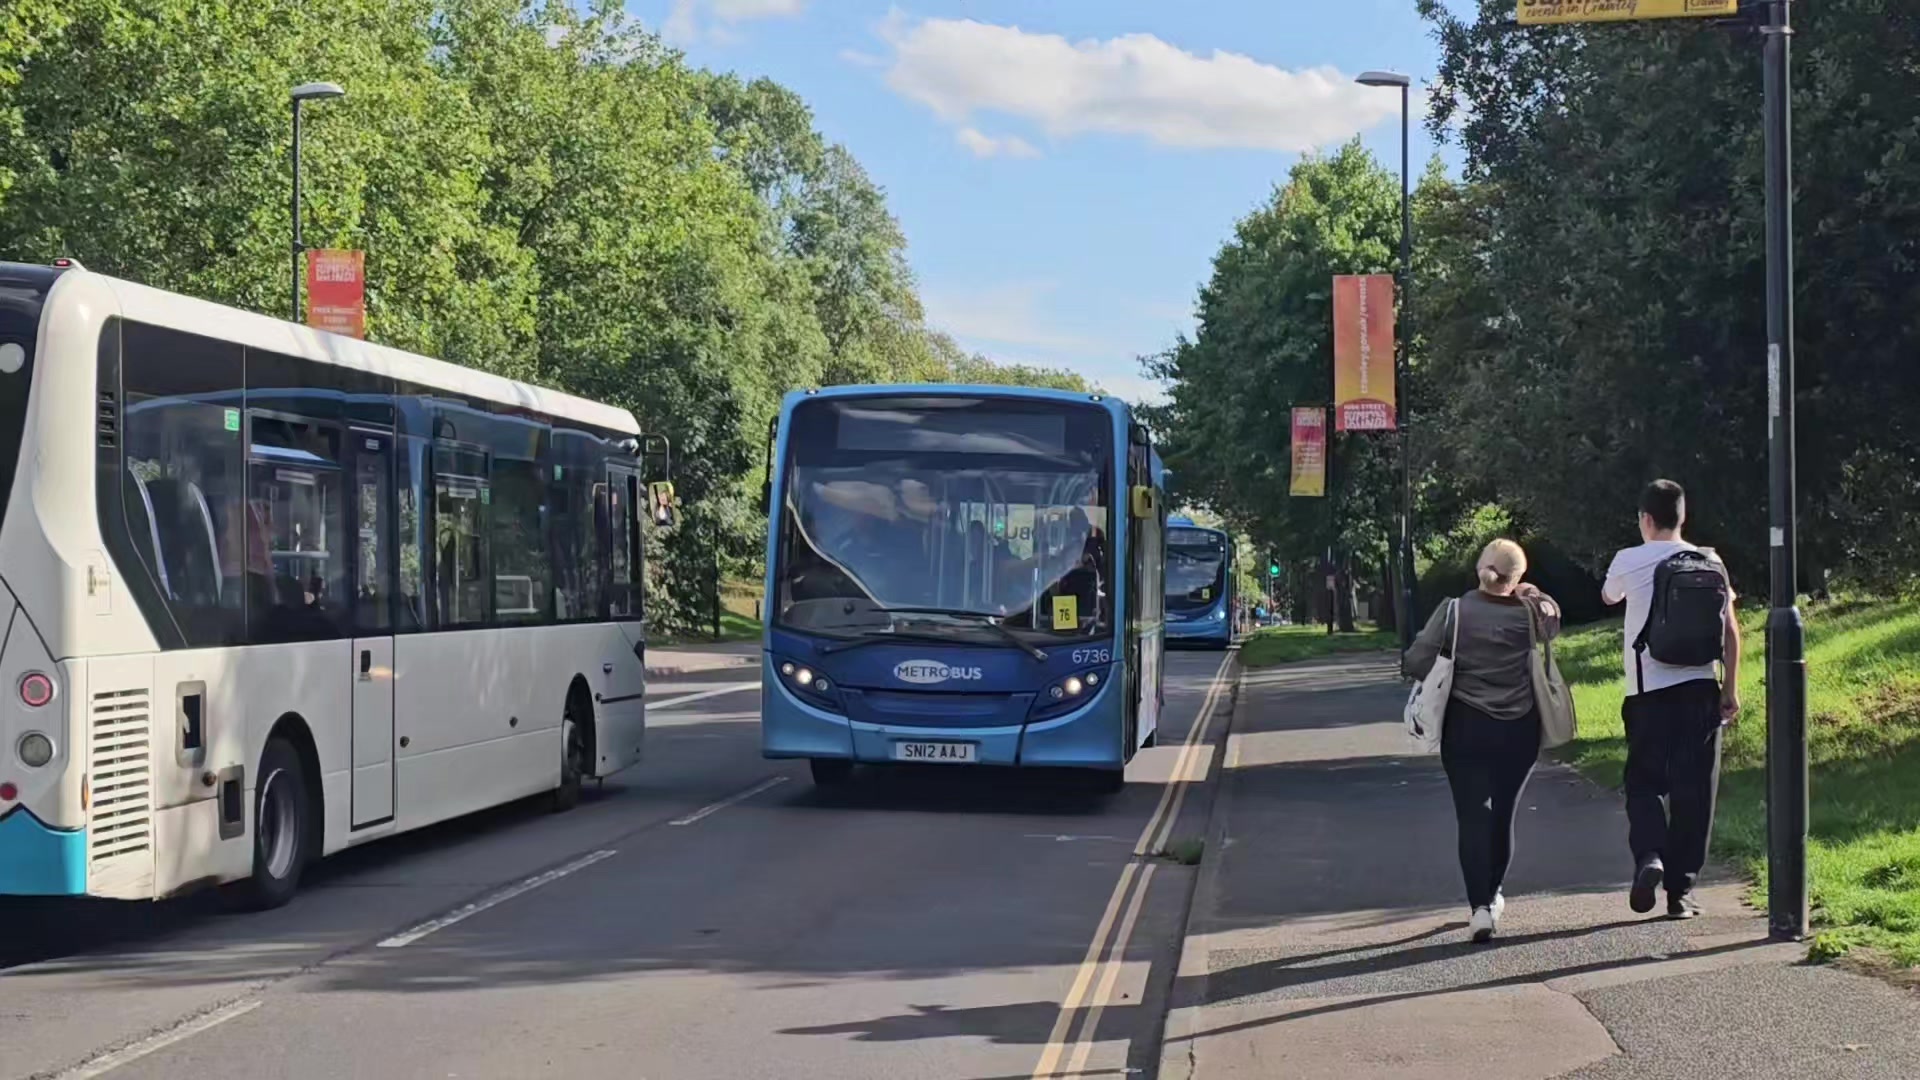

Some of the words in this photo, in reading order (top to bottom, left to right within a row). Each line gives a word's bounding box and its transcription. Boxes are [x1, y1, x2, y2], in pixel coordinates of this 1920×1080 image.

[1525, 5, 1563, 17] events
[1567, 5, 1579, 14] in
[1059, 608, 1071, 621] 76
[1072, 649, 1110, 664] 6736
[897, 665, 983, 681] METROBUS
[905, 744, 936, 759] SN12
[940, 745, 967, 759] AAJ
